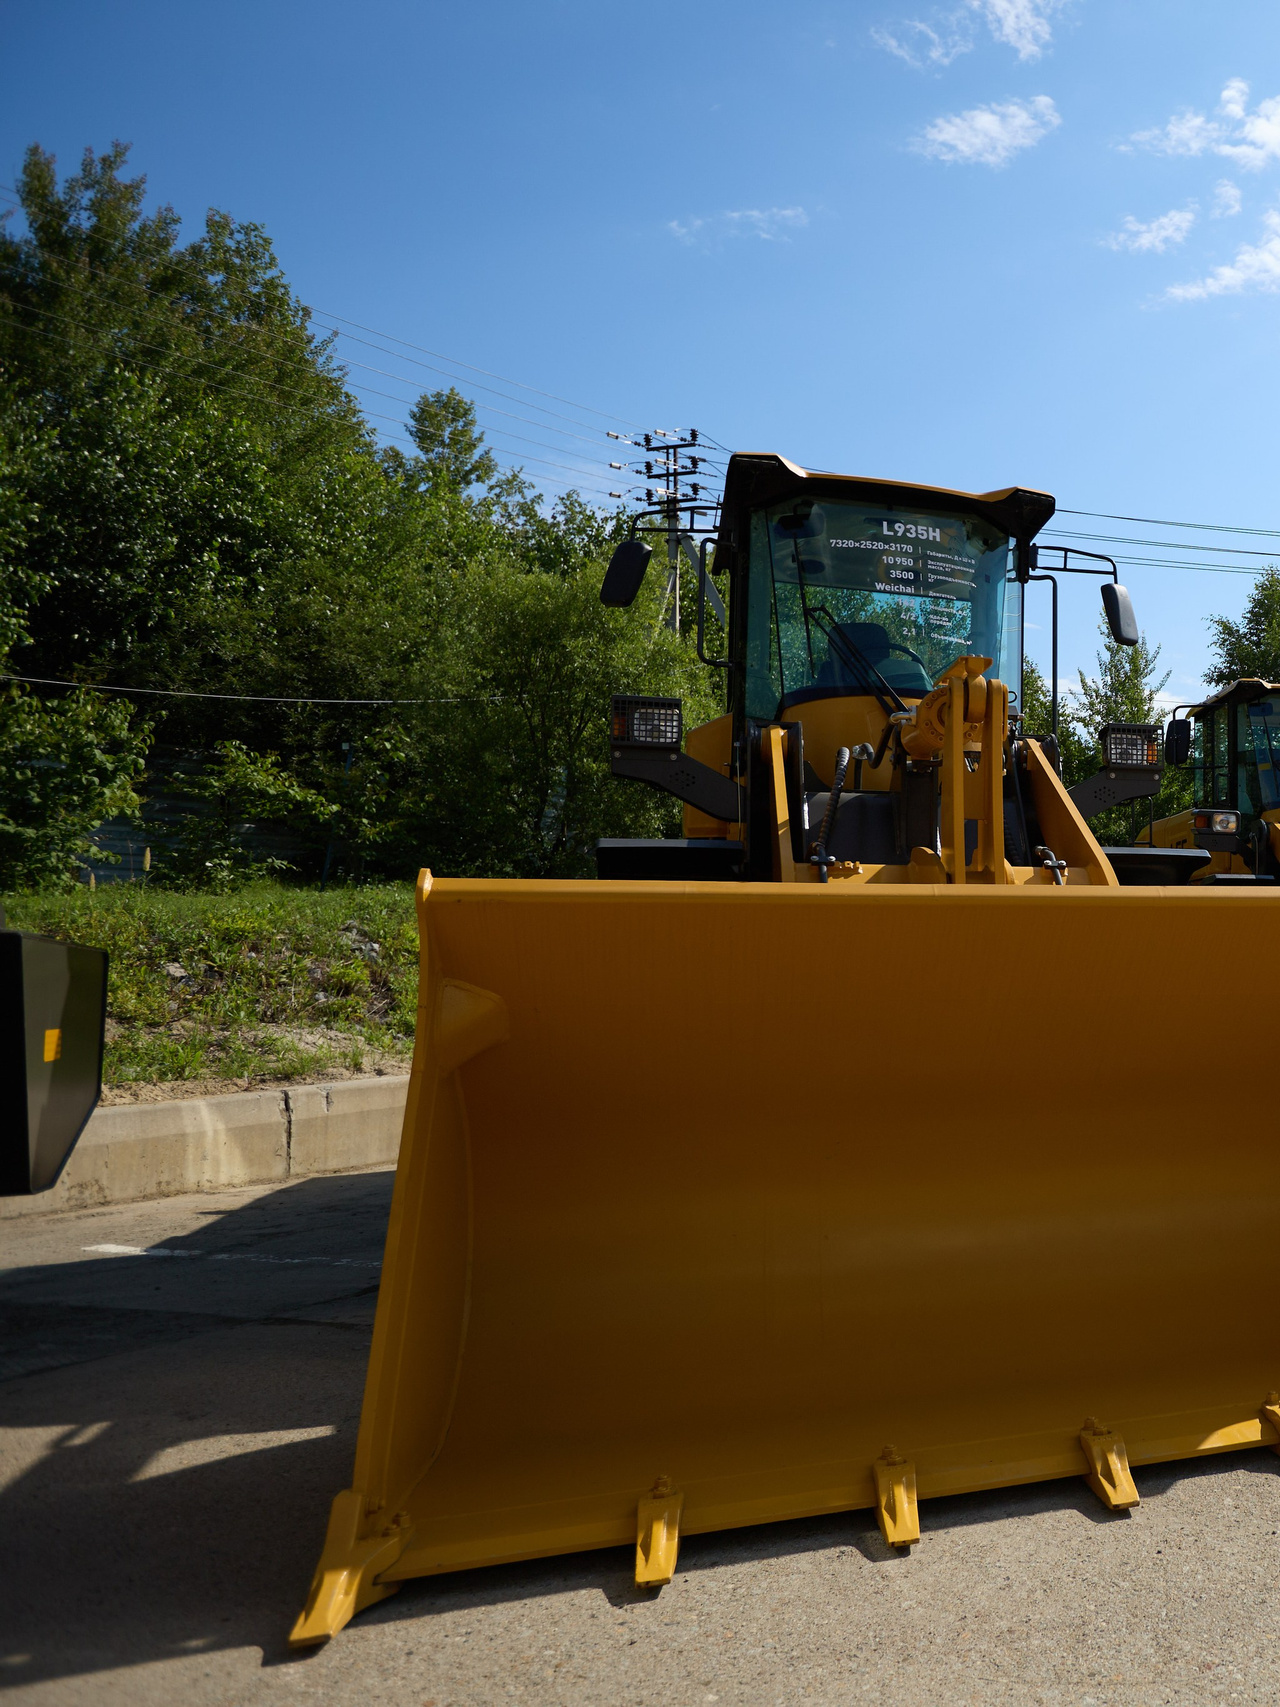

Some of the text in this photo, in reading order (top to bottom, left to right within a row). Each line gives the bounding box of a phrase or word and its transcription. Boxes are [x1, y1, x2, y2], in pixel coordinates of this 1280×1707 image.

[882, 521, 941, 542] L935H
[927, 551, 954, 560] Габариты,
[889, 570, 914, 580] 3500
[874, 582, 915, 594] Weichai
[928, 591, 957, 600] Двигатель
[900, 612, 917, 620] 4/2
[902, 627, 916, 636] 2,1
